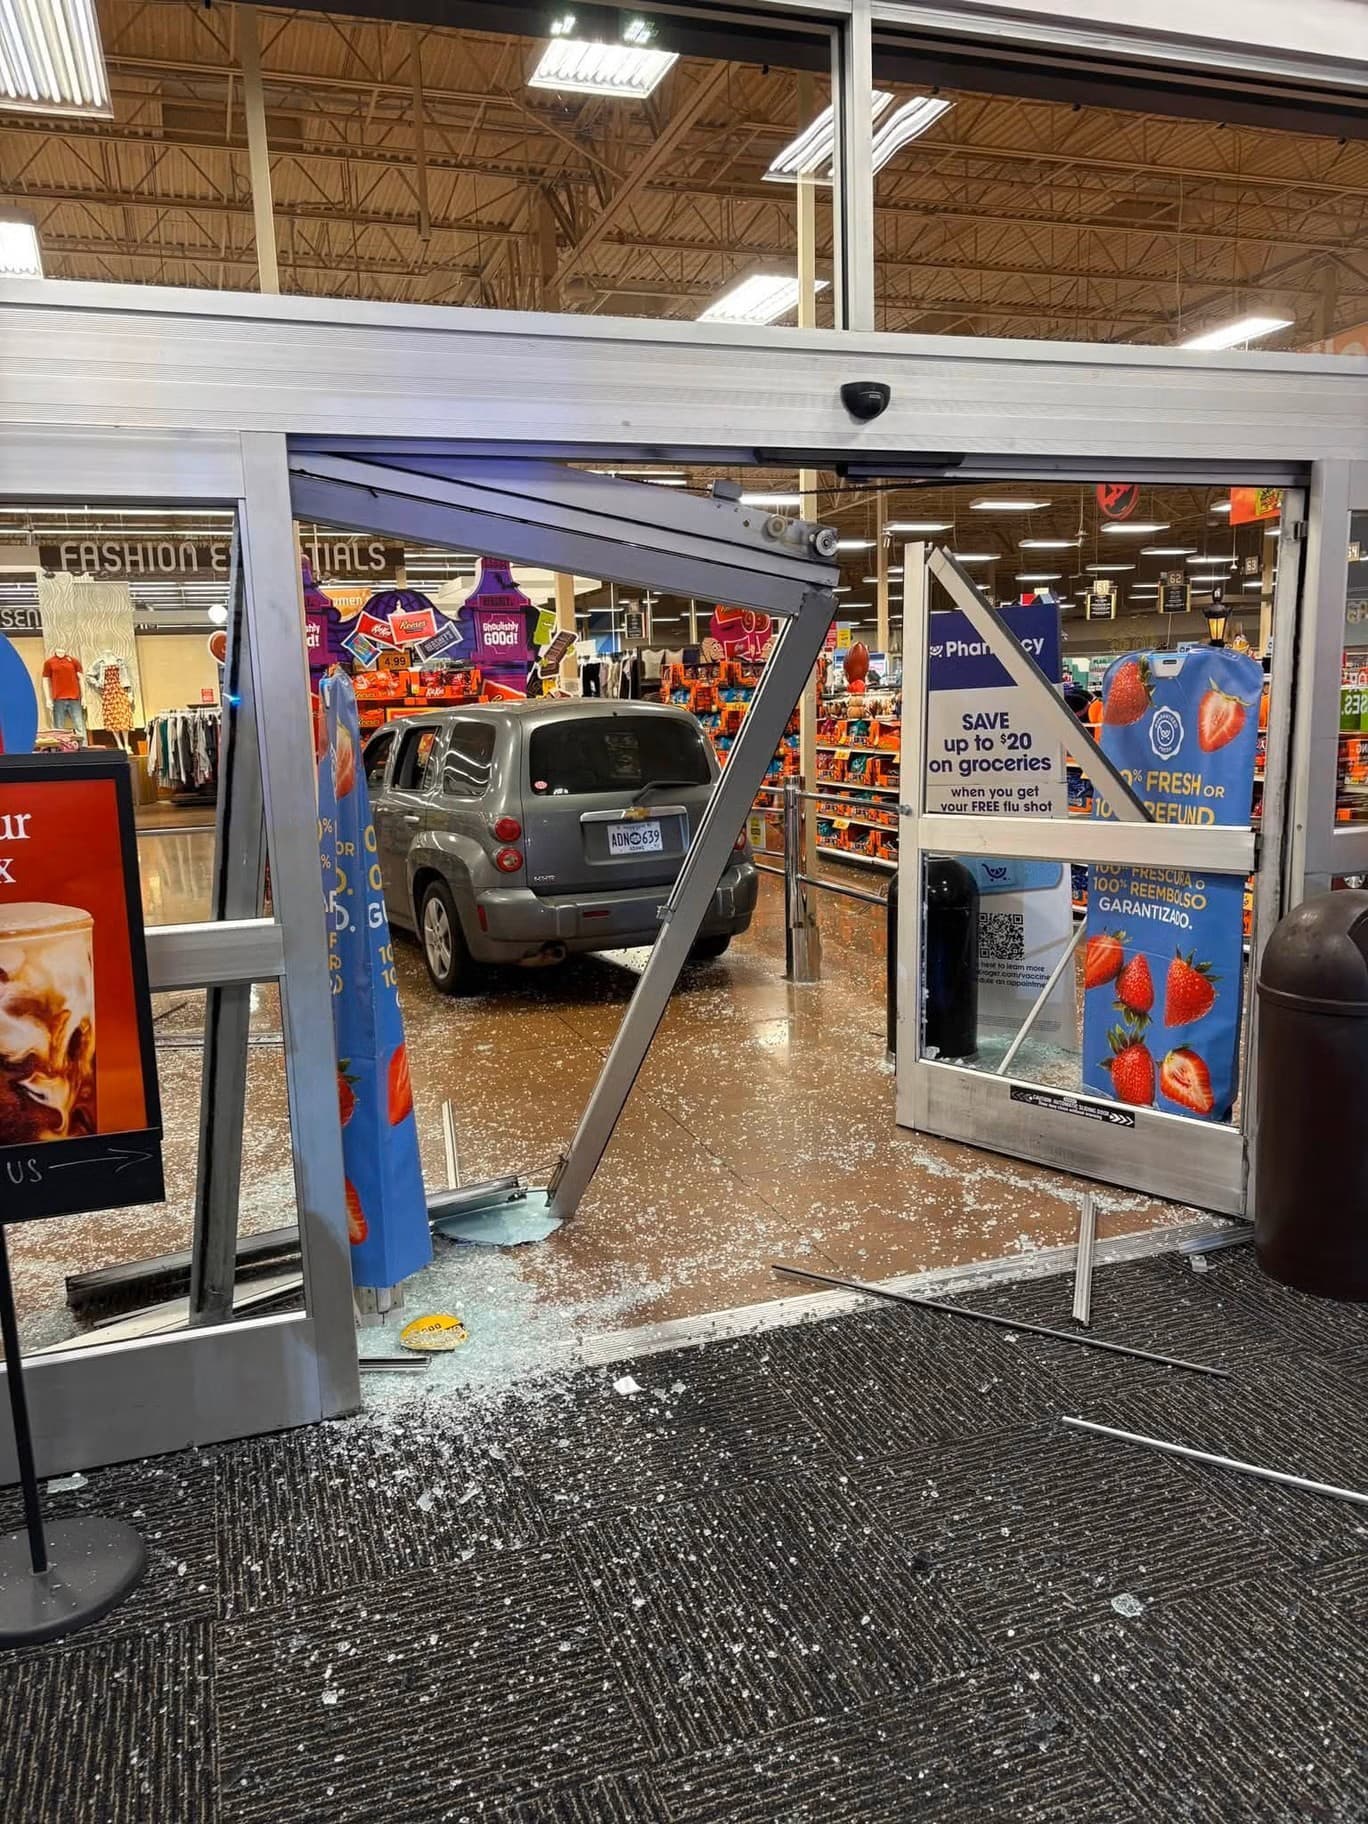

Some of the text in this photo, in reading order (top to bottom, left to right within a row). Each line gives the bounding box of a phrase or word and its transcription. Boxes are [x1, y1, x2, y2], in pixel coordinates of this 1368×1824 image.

[60, 541, 198, 573] FASHION
[1169, 574, 1181, 584] 62
[482, 620, 519, 633] Ghoulishly
[945, 635, 1044, 657] Pharcy
[384, 657, 407, 666] 4.99
[962, 711, 1010, 731] SAVE
[943, 732, 1032, 757] up to $20
[929, 754, 1052, 777] on groceries
[951, 785, 1040, 800] when you get
[1146, 769, 1202, 796] FRESH
[1203, 784, 1225, 799] OR
[940, 800, 1054, 813] your FREE flu shot
[611, 829, 660, 848] ADN 639
[1093, 876, 1208, 910] 100% REEMBOLSO
[1098, 896, 1193, 931] GARANTIZADO.
[7, 1158, 42, 1184] US
